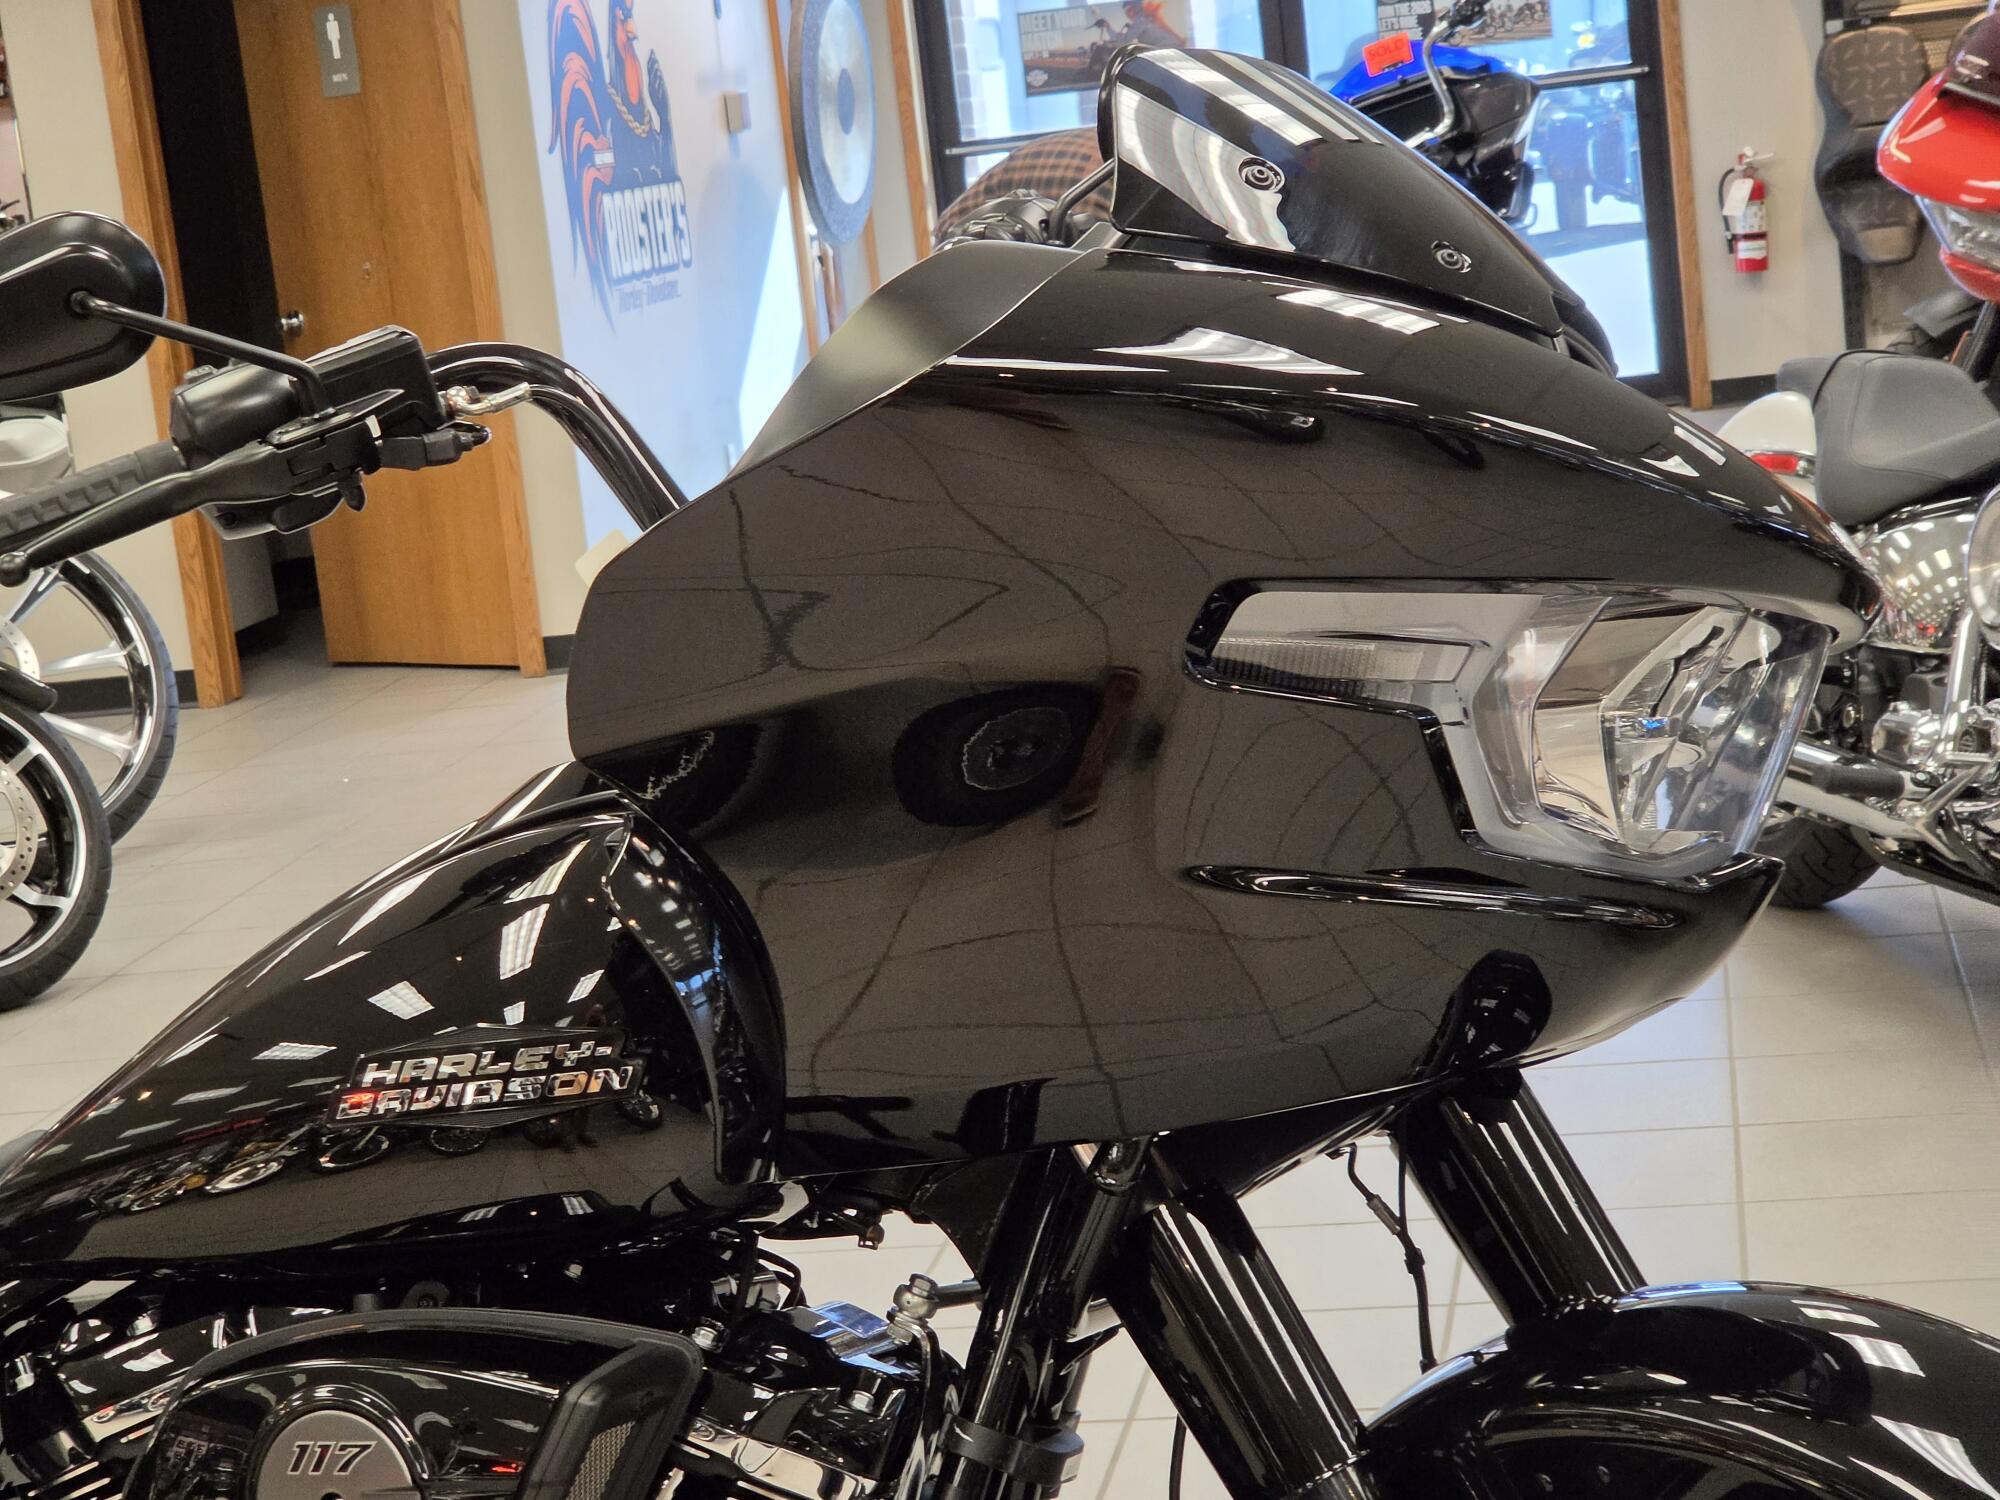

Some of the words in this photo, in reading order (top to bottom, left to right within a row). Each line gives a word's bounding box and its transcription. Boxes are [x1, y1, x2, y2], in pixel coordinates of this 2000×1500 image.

[1368, 38, 1404, 60] SOLD
[602, 180, 692, 279] ROOSTER'S
[361, 1041, 613, 1087] HARLEY-
[336, 1066, 633, 1120] DAVIDSON
[287, 1441, 377, 1476] 117
